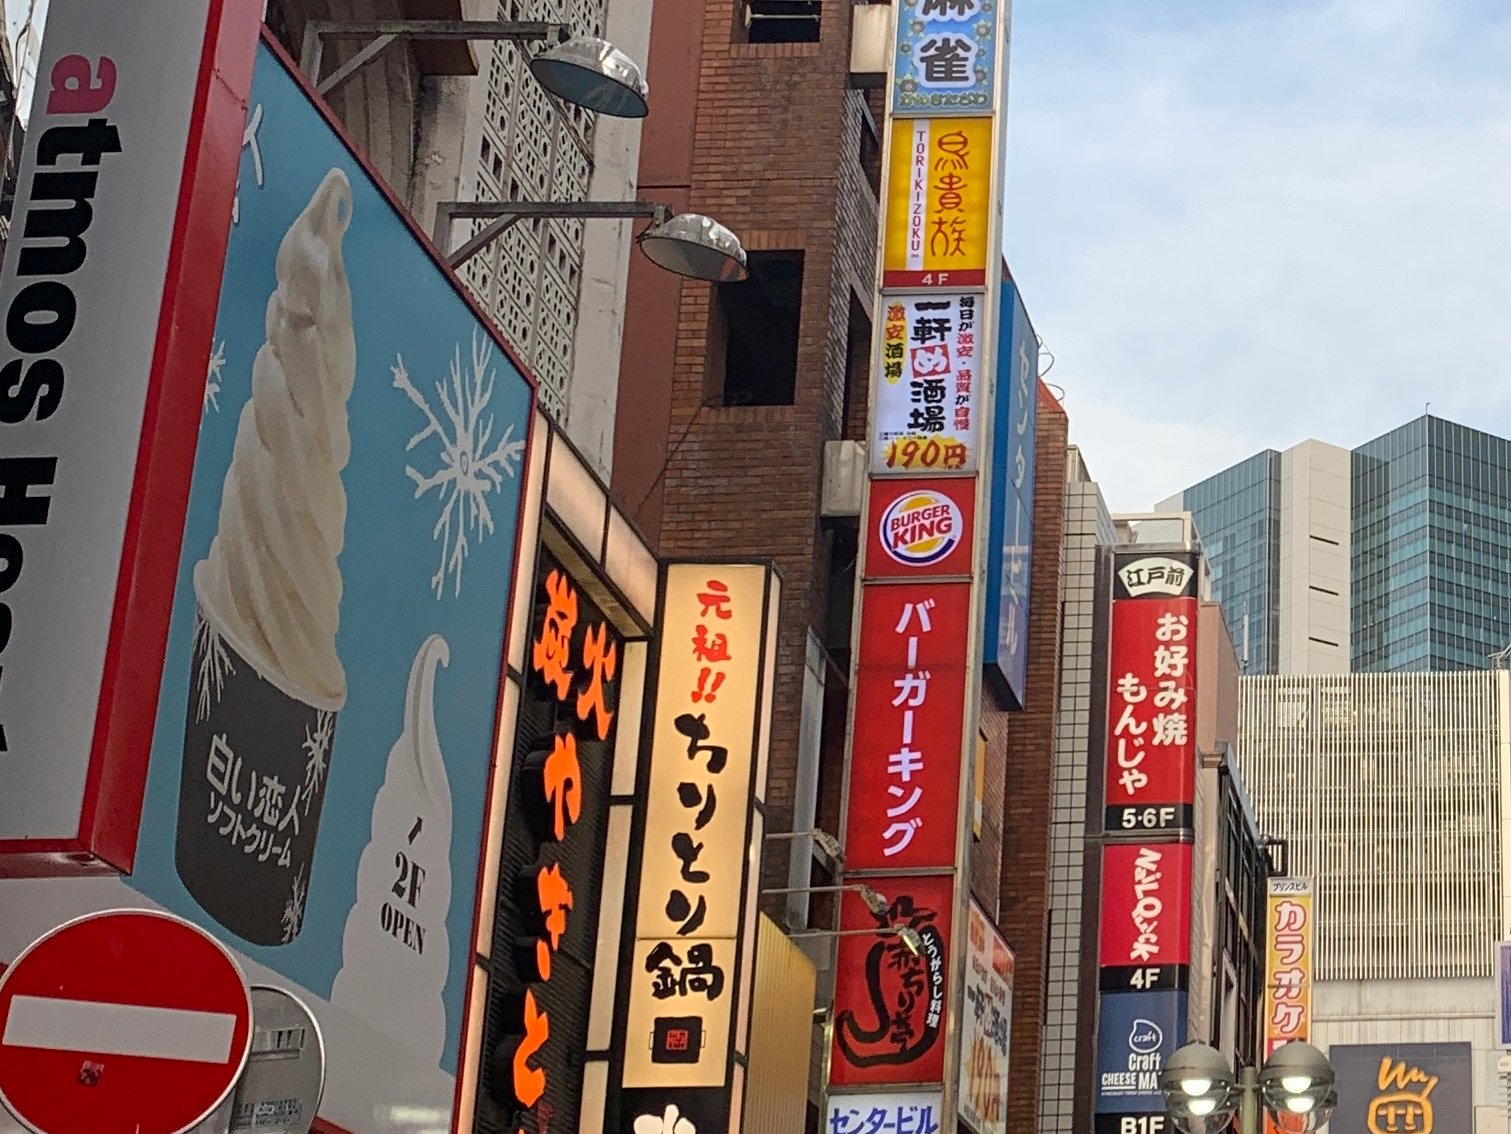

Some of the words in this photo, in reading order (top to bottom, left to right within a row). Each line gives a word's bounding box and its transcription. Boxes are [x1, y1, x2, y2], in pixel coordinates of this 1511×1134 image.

[910, 130, 927, 252] TORIKIZOKU
[0, 53, 122, 424] atmos
[907, 300, 952, 433] 一軒め酒場
[885, 440, 968, 468] 190円
[889, 504, 951, 531] BURGER
[891, 517, 953, 550] KING
[1126, 565, 1186, 588] 江戸前
[1151, 612, 1190, 746] お好み焼
[881, 598, 936, 857] バーガーキング
[1113, 672, 1149, 796] もんじゃ
[205, 732, 302, 836] 白い恋人
[206, 799, 293, 869] ソフトクリーム
[391, 851, 427, 907] 2F
[380, 902, 427, 955] OPEN
[1129, 967, 1161, 989] 4F
[1271, 899, 1307, 1035] カラオケ
[1101, 1070, 1137, 1087] CHEESE
[1128, 1052, 1161, 1072] Craft
